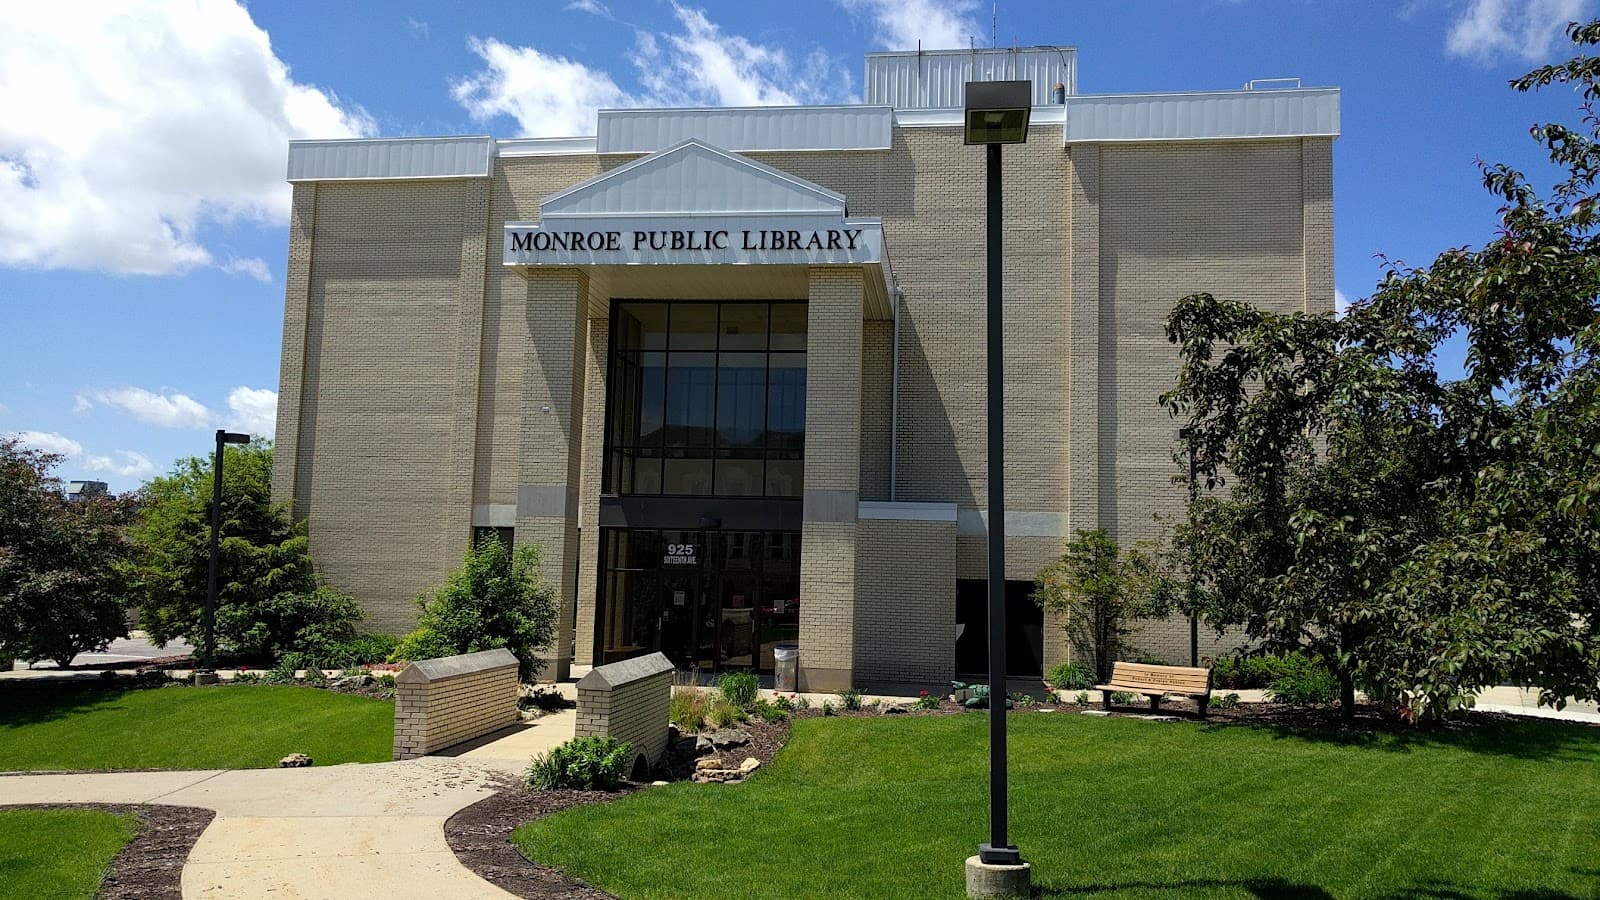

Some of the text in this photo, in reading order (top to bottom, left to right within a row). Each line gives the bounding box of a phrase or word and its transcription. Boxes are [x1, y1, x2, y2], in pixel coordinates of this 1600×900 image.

[510, 229, 862, 251] MONROE PUBLIC LIBRARY
[667, 543, 694, 555] 925
[663, 556, 687, 564] SIXTEENTH
